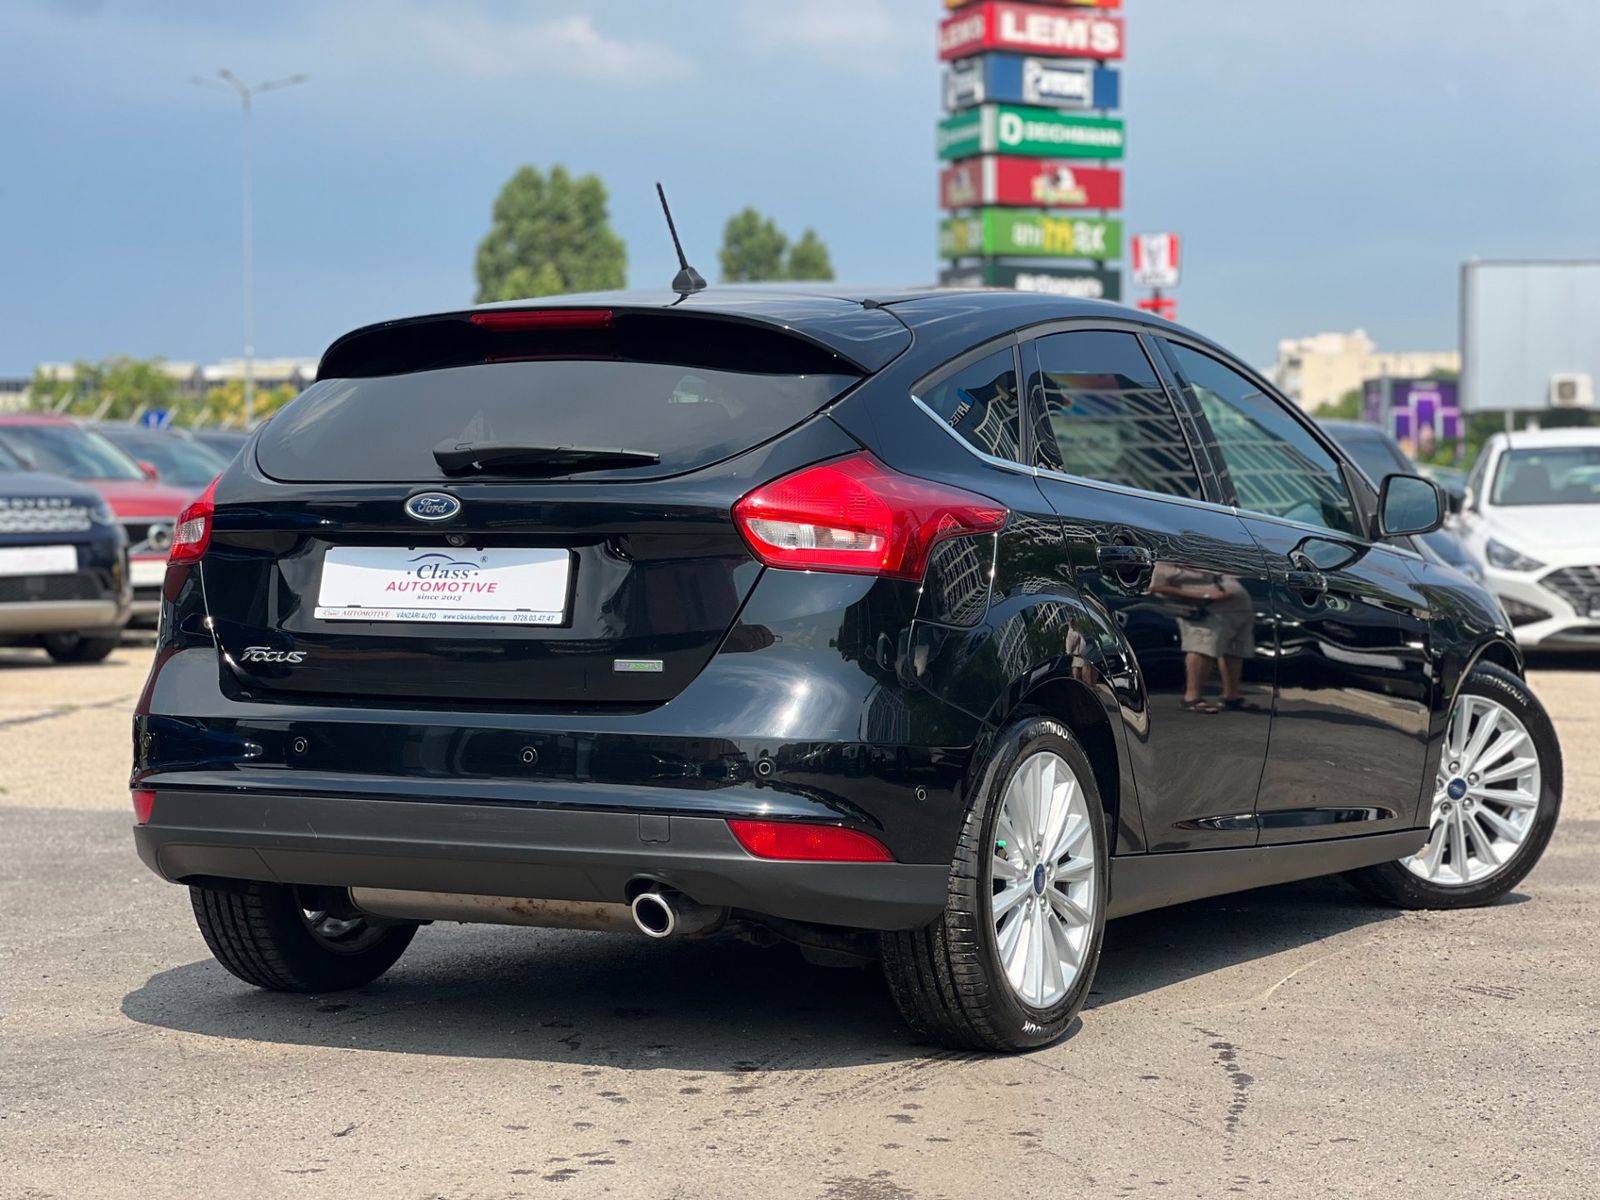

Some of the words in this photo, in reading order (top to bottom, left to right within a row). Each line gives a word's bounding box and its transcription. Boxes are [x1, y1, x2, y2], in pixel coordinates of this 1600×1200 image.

[417, 498, 448, 513] Ford
[416, 563, 470, 580] Class
[385, 581, 498, 594] AUTOMOTIVE
[416, 593, 439, 601] since
[441, 594, 462, 602] 2013
[342, 610, 389, 618] AUTOMOTIVE
[421, 612, 437, 620] AUTO
